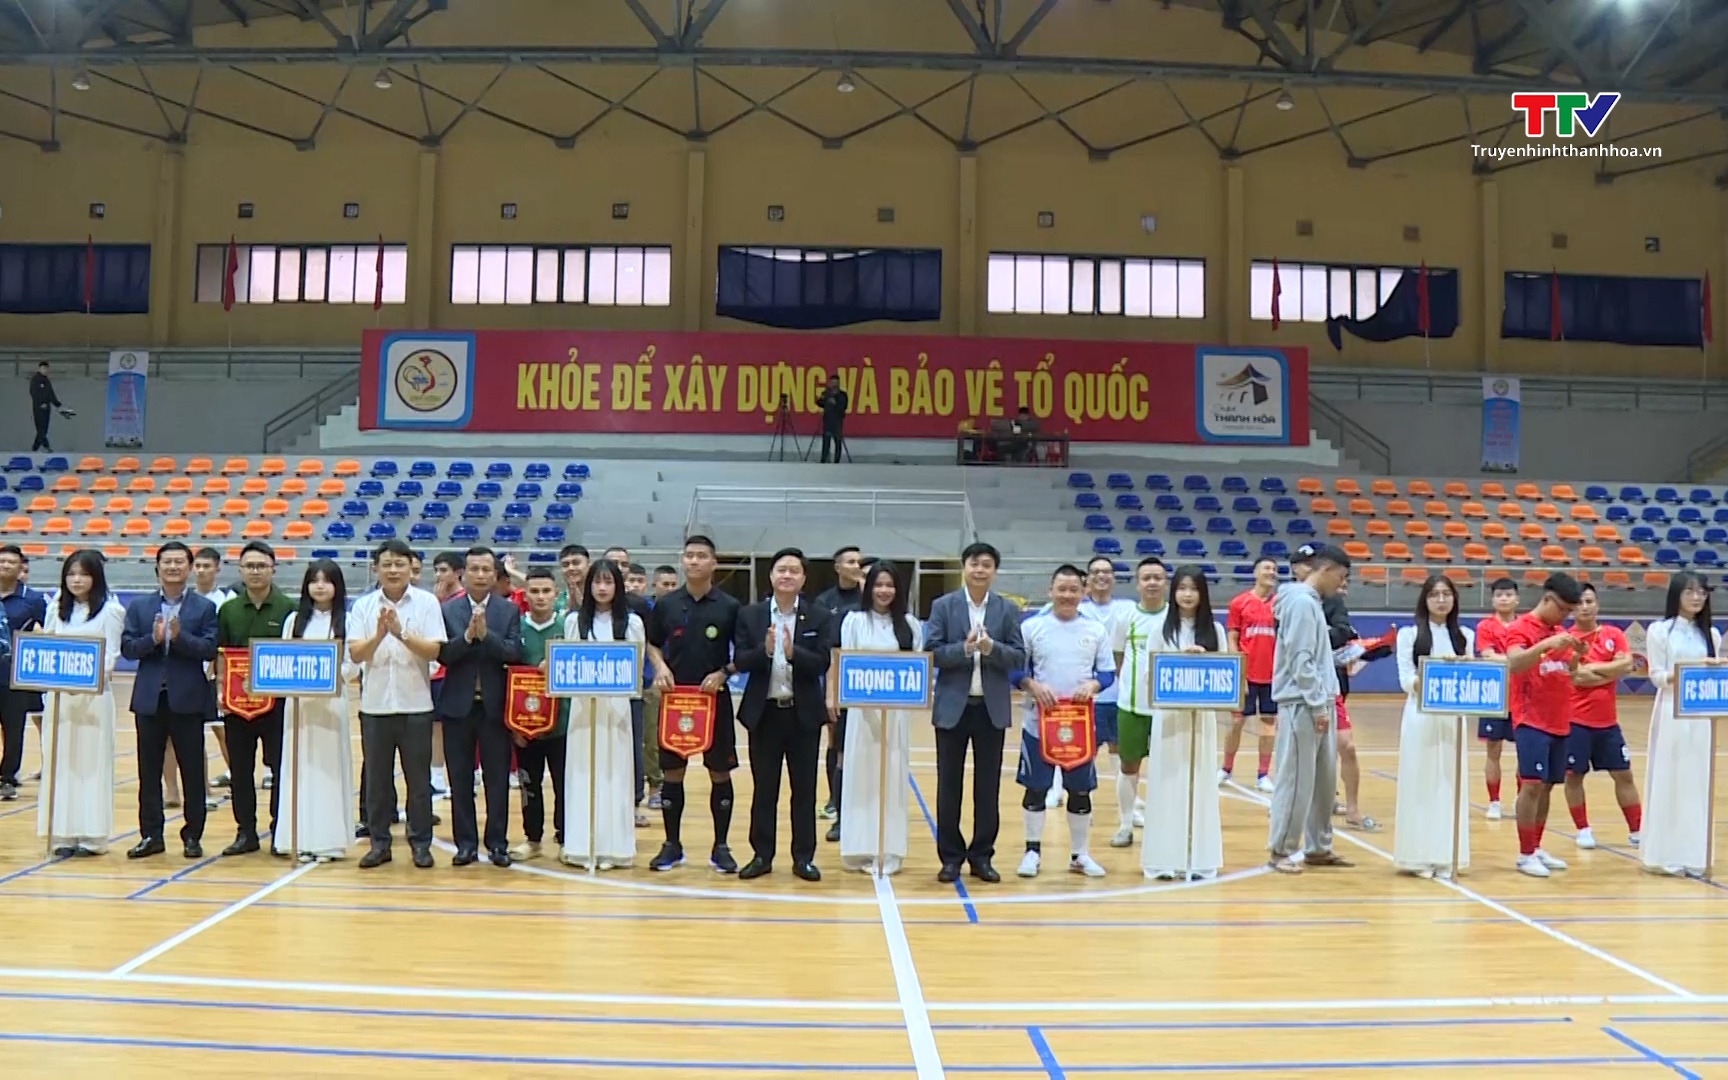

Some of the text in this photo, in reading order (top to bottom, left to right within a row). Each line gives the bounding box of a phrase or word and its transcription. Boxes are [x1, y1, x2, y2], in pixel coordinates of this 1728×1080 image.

[517, 347, 600, 411] KHỎE
[611, 344, 656, 411] ĐỂ
[663, 354, 728, 412] XÂY
[737, 361, 828, 424] DỰNG
[837, 356, 880, 415] VÀ
[890, 351, 955, 416] BẢO
[1013, 352, 1055, 419] TỔ
[1064, 357, 1149, 424] QUỐC
[22, 648, 94, 677] FC THE TIGERS
[259, 655, 318, 680] VPBANK-TTTC
[319, 656, 331, 680] TH
[555, 660, 566, 684] FC
[846, 665, 921, 695] TRỌNG TÀI
[1160, 667, 1172, 693] FC
[1428, 677, 1440, 702] FC
[1481, 677, 1500, 704] SƠN
[1685, 679, 1697, 701] FC
[1698, 677, 1718, 701] SƠN
